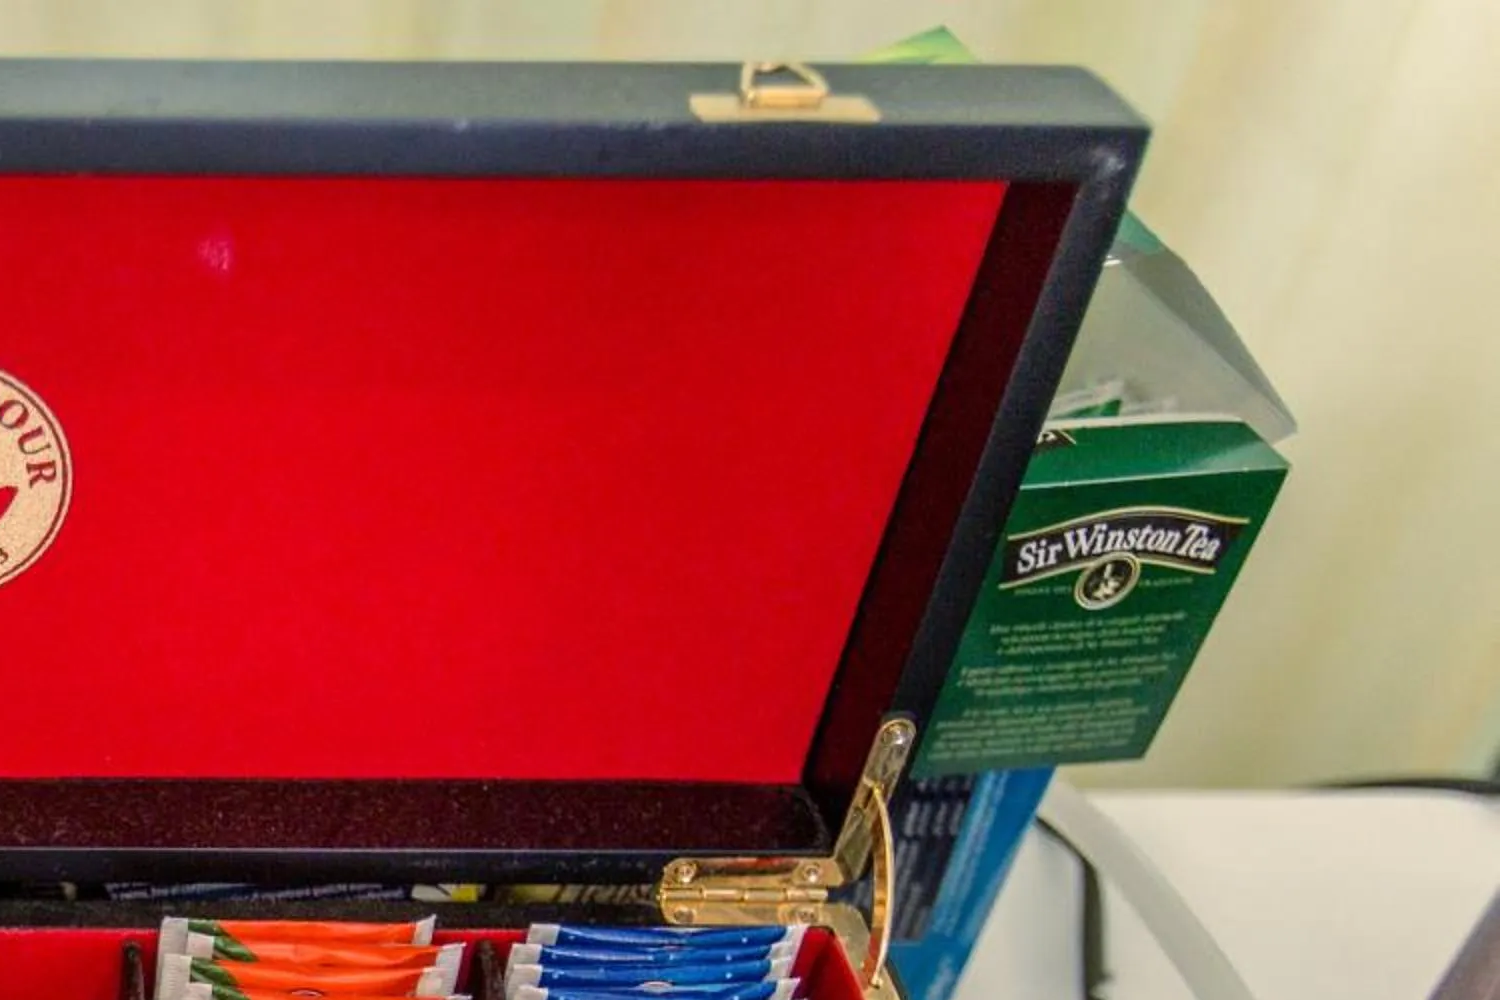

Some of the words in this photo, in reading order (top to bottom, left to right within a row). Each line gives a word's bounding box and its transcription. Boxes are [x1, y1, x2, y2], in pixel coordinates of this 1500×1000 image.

[1016, 540, 1063, 574] Sir
[1064, 523, 1182, 558] Winston
[1177, 523, 1221, 561] Tea
